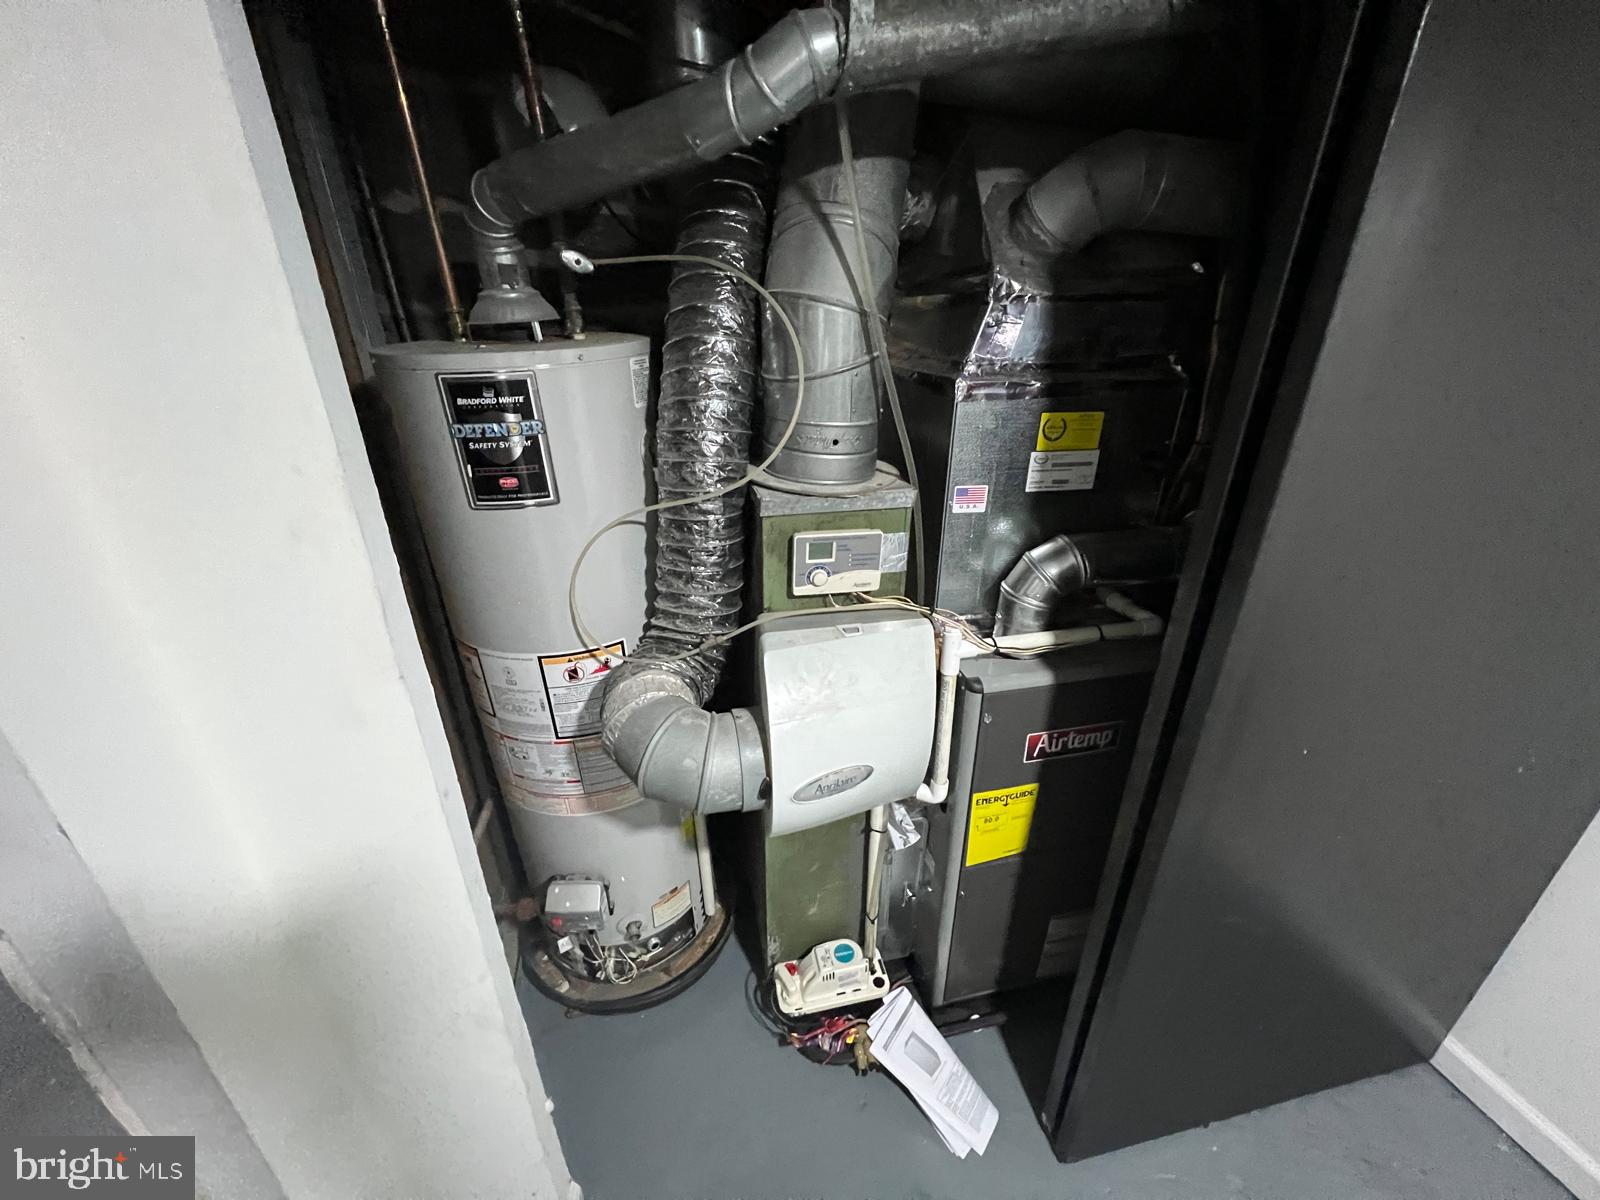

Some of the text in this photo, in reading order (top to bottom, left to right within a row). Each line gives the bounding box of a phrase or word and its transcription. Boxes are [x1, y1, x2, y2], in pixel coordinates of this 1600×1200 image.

[456, 395, 524, 406] BRADFORD WHITE
[452, 420, 545, 438] DEFENDER
[468, 440, 532, 450] SAFETY SYSM
[1033, 729, 1113, 757] Airtemp
[976, 789, 1035, 807] ENERGYGUIDE
